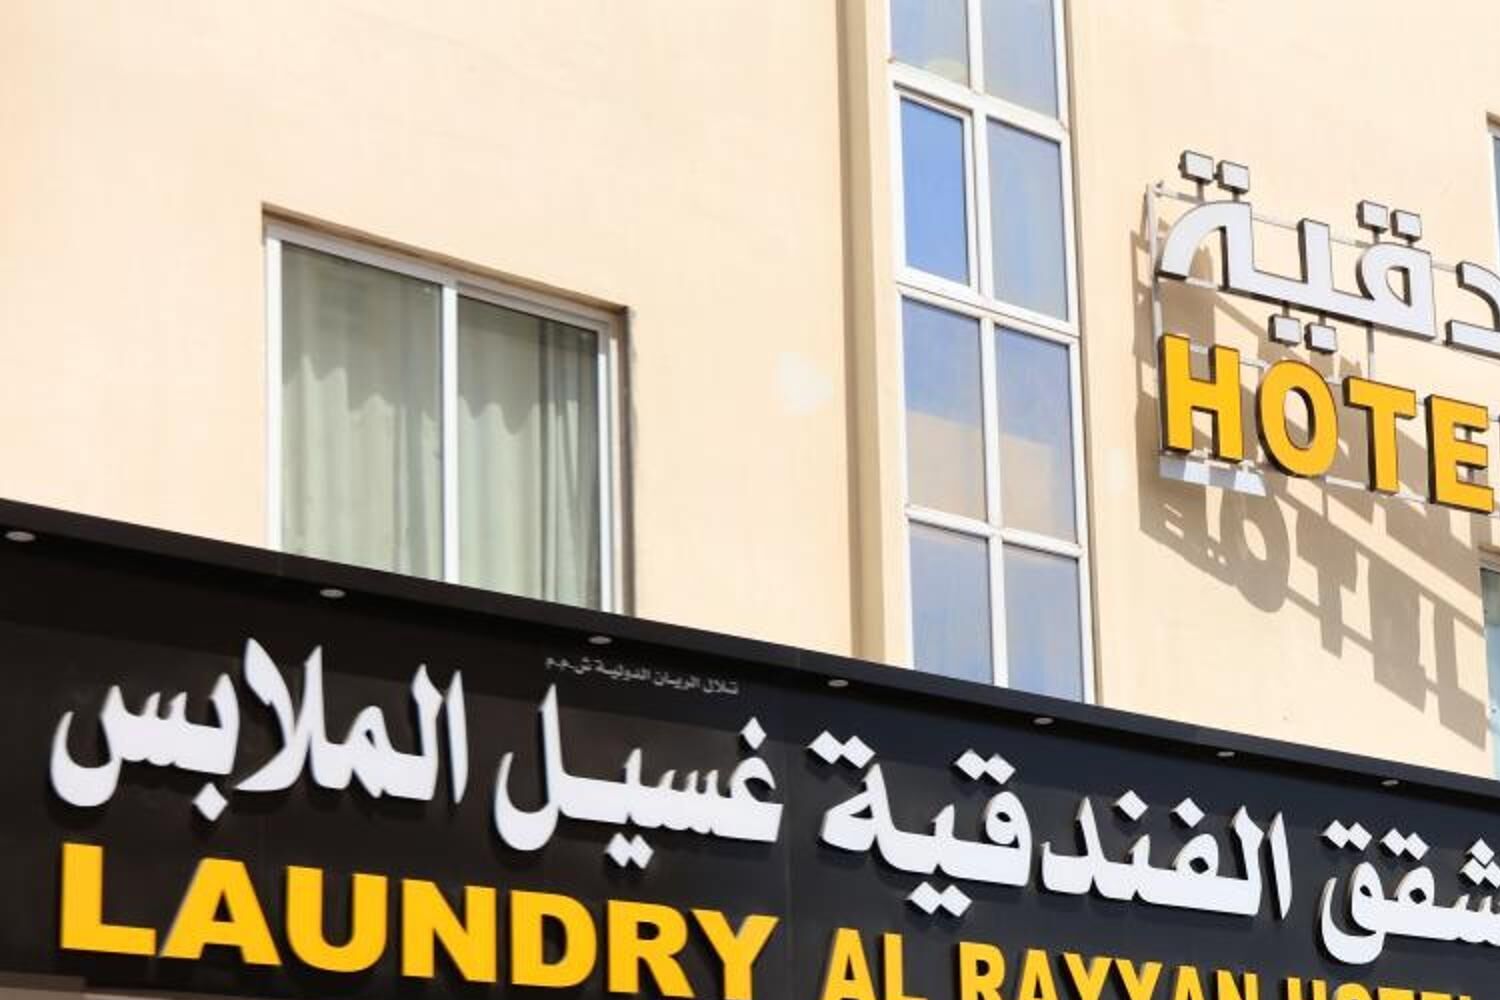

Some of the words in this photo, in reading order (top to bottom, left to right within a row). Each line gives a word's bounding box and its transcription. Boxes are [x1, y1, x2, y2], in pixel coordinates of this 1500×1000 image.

[51, 637, 468, 822] الملابس
[494, 684, 783, 869] غسيل
[806, 730, 1293, 920] الفندقية
